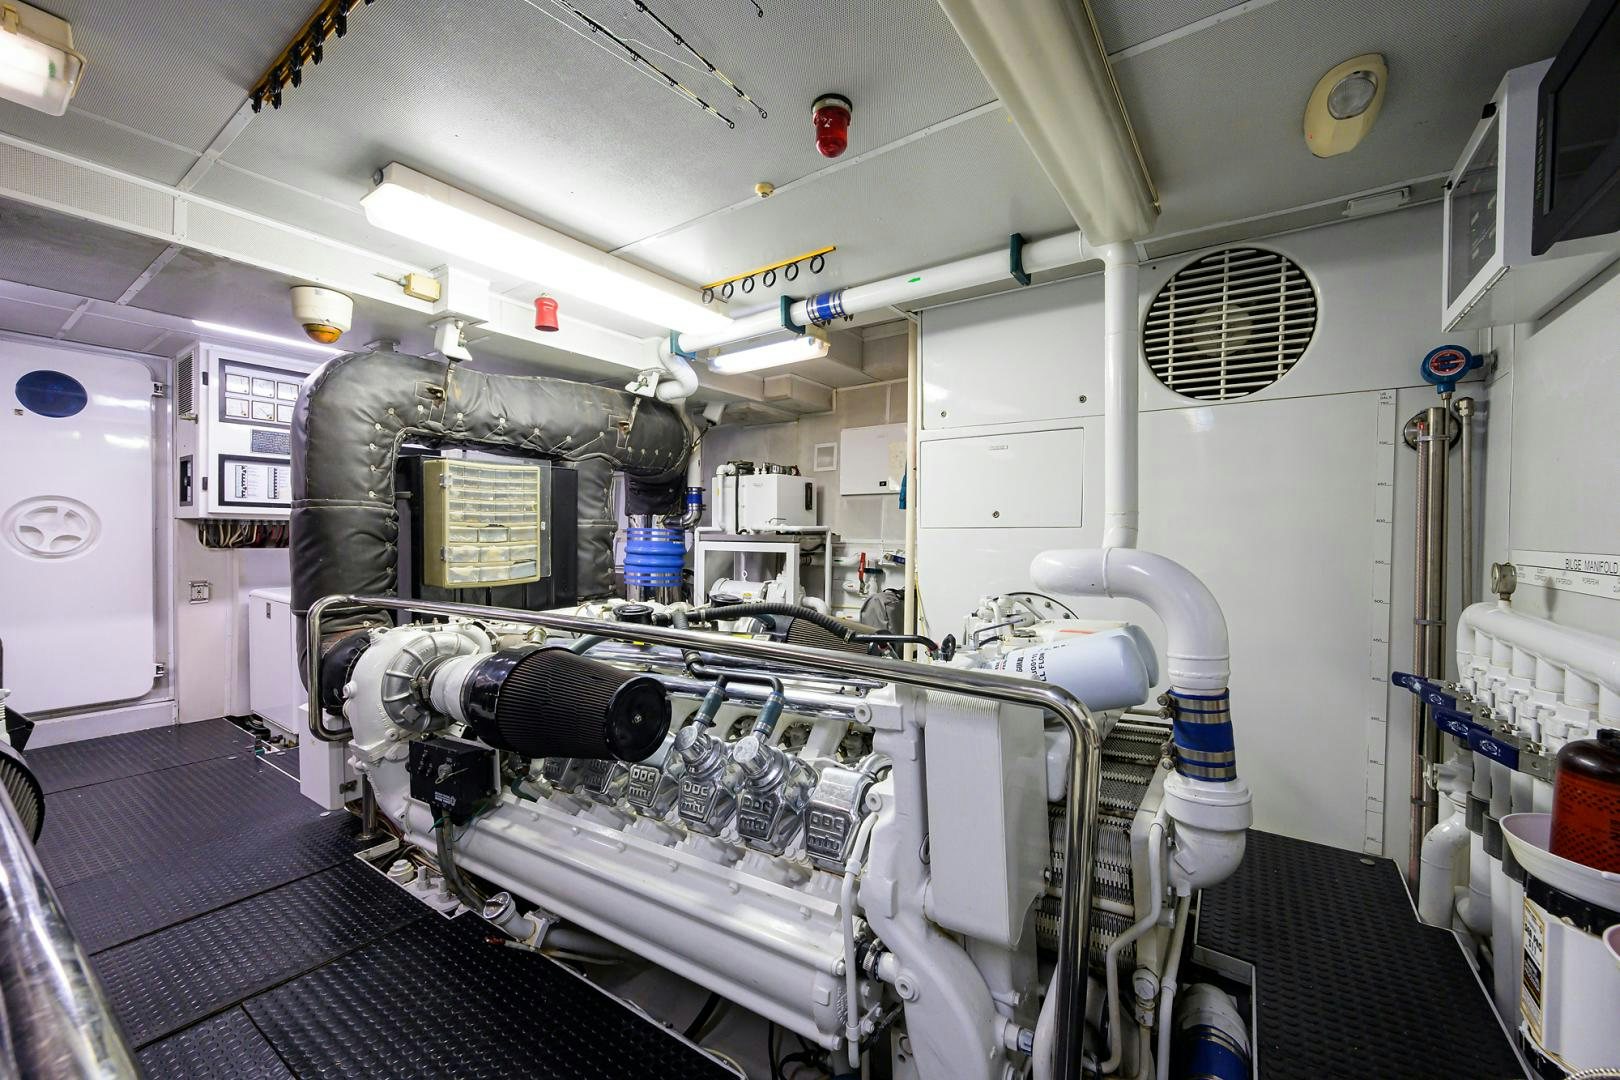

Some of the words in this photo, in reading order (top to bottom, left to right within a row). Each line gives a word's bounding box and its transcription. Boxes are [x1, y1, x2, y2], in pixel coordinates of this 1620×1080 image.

[1565, 558, 1582, 571] BILGE
[1584, 559, 1619, 575] MANIFOLD
[632, 768, 656, 783] DDC
[629, 786, 651, 798] mtu
[683, 780, 709, 796] DDC
[681, 800, 706, 814] mtu
[740, 814, 768, 830] mtu
[811, 811, 845, 831] DDC
[808, 834, 841, 852] mtu
